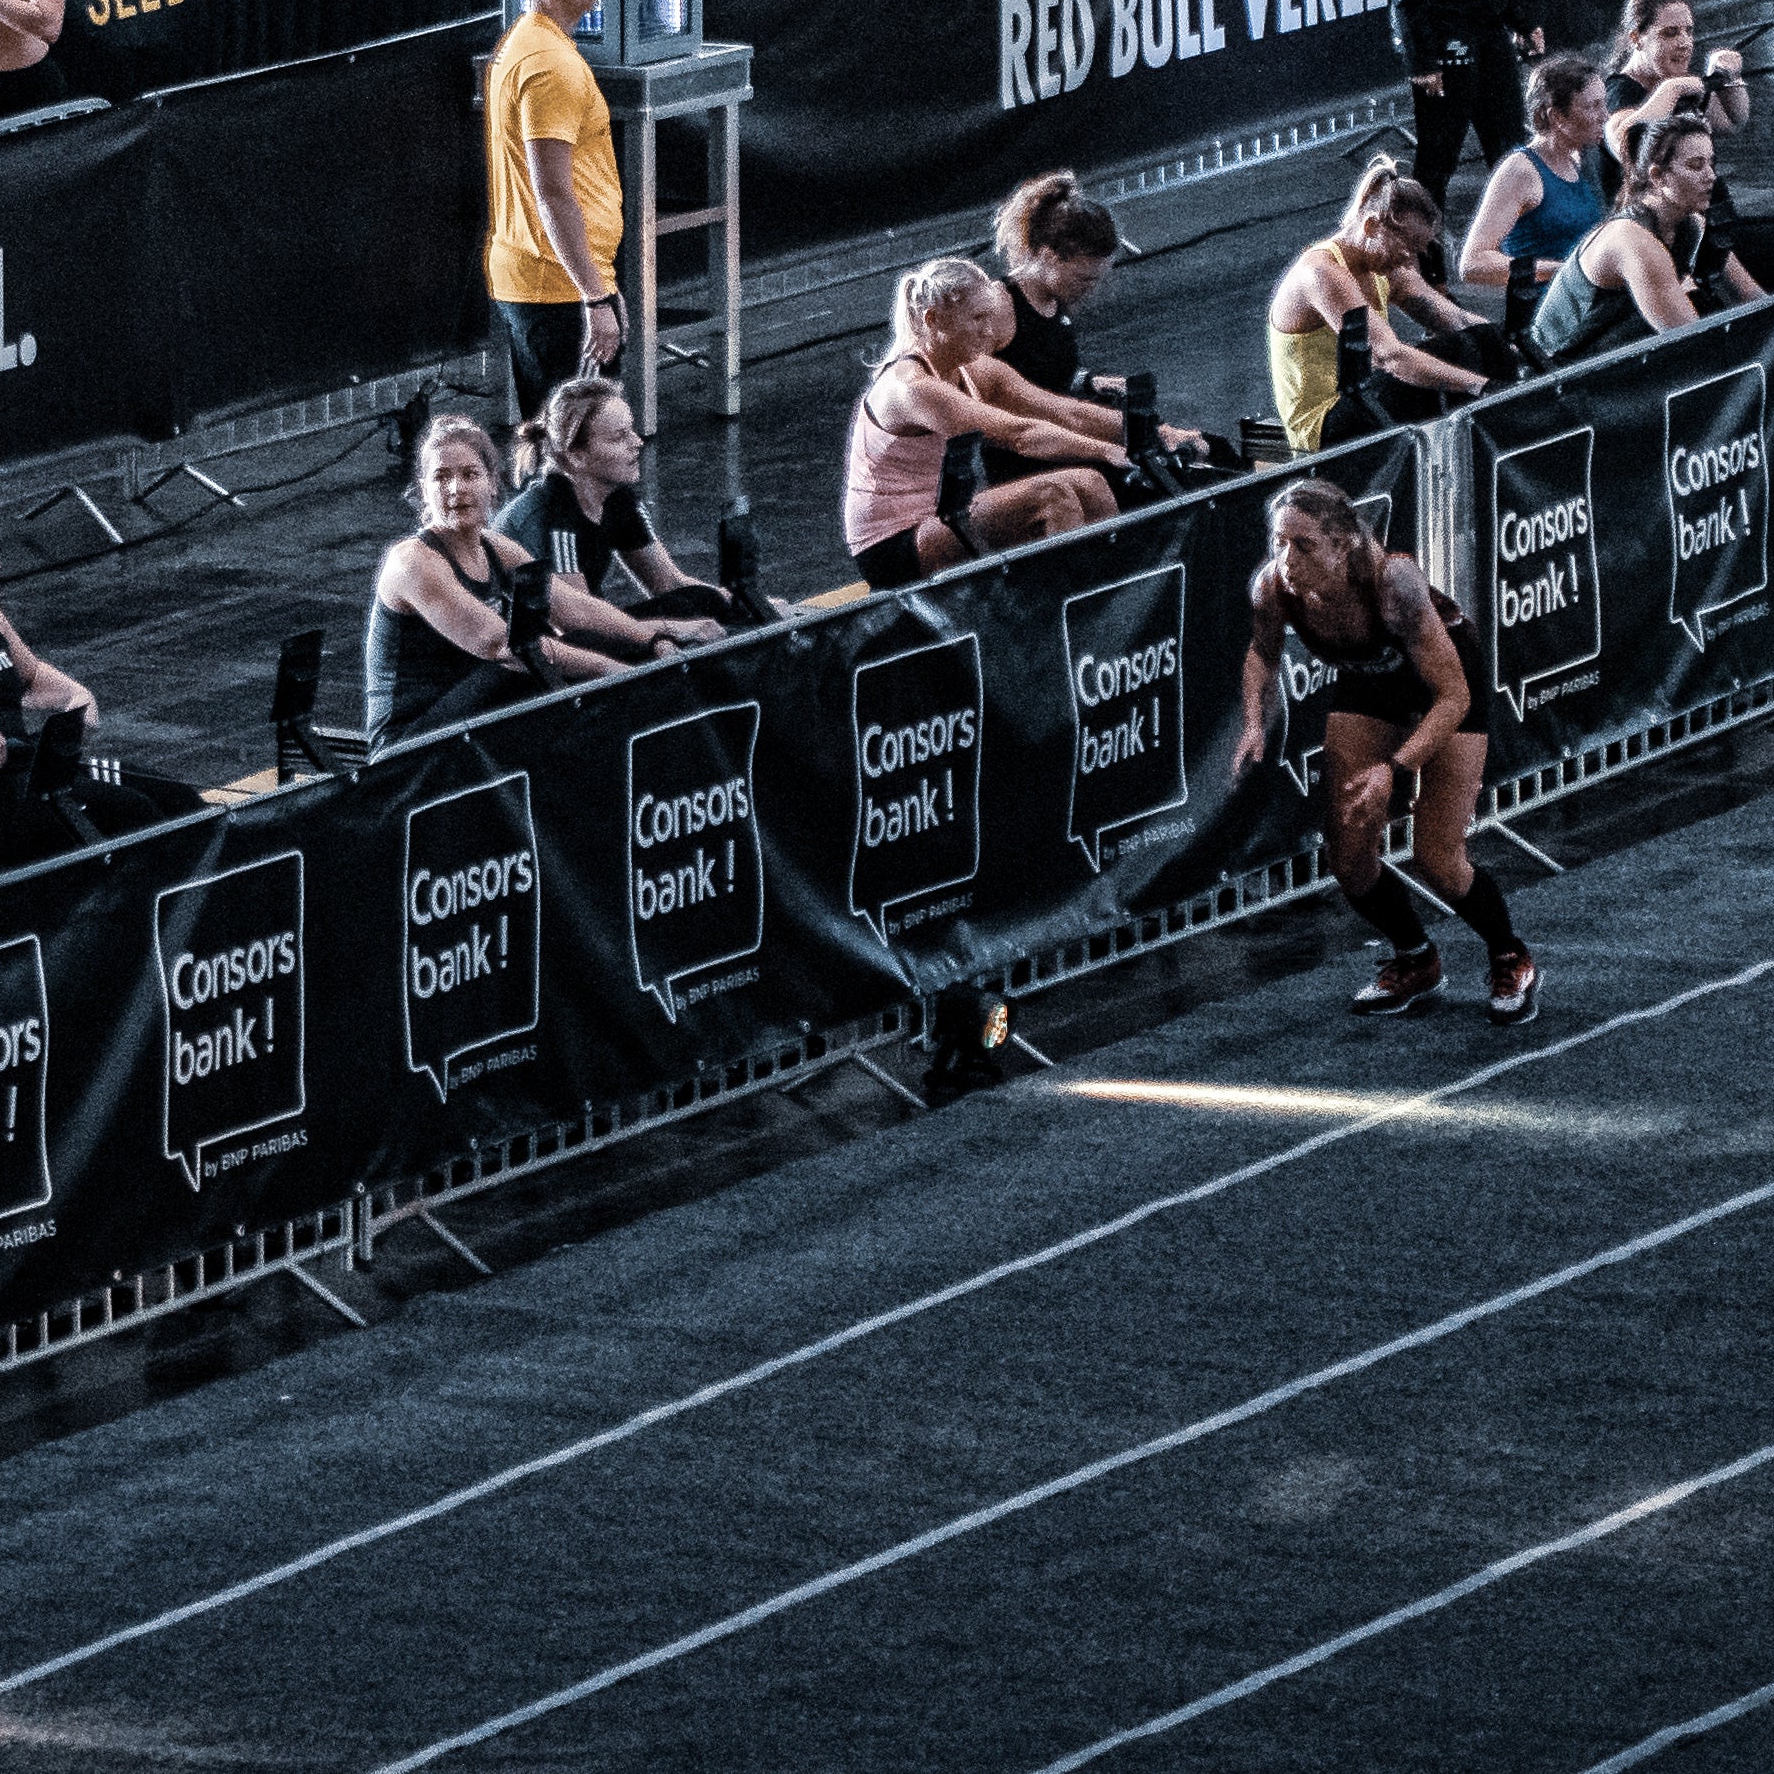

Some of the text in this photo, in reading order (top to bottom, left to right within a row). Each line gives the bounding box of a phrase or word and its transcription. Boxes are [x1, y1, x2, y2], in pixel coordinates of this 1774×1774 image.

[1671, 427, 1759, 499] Consors
[1499, 489, 1589, 565] Consors
[1077, 633, 1177, 710] Consors
[861, 703, 977, 780] Consors
[634, 772, 750, 851] Consors
[410, 847, 533, 927] Consors
[170, 929, 296, 1011] Consors
